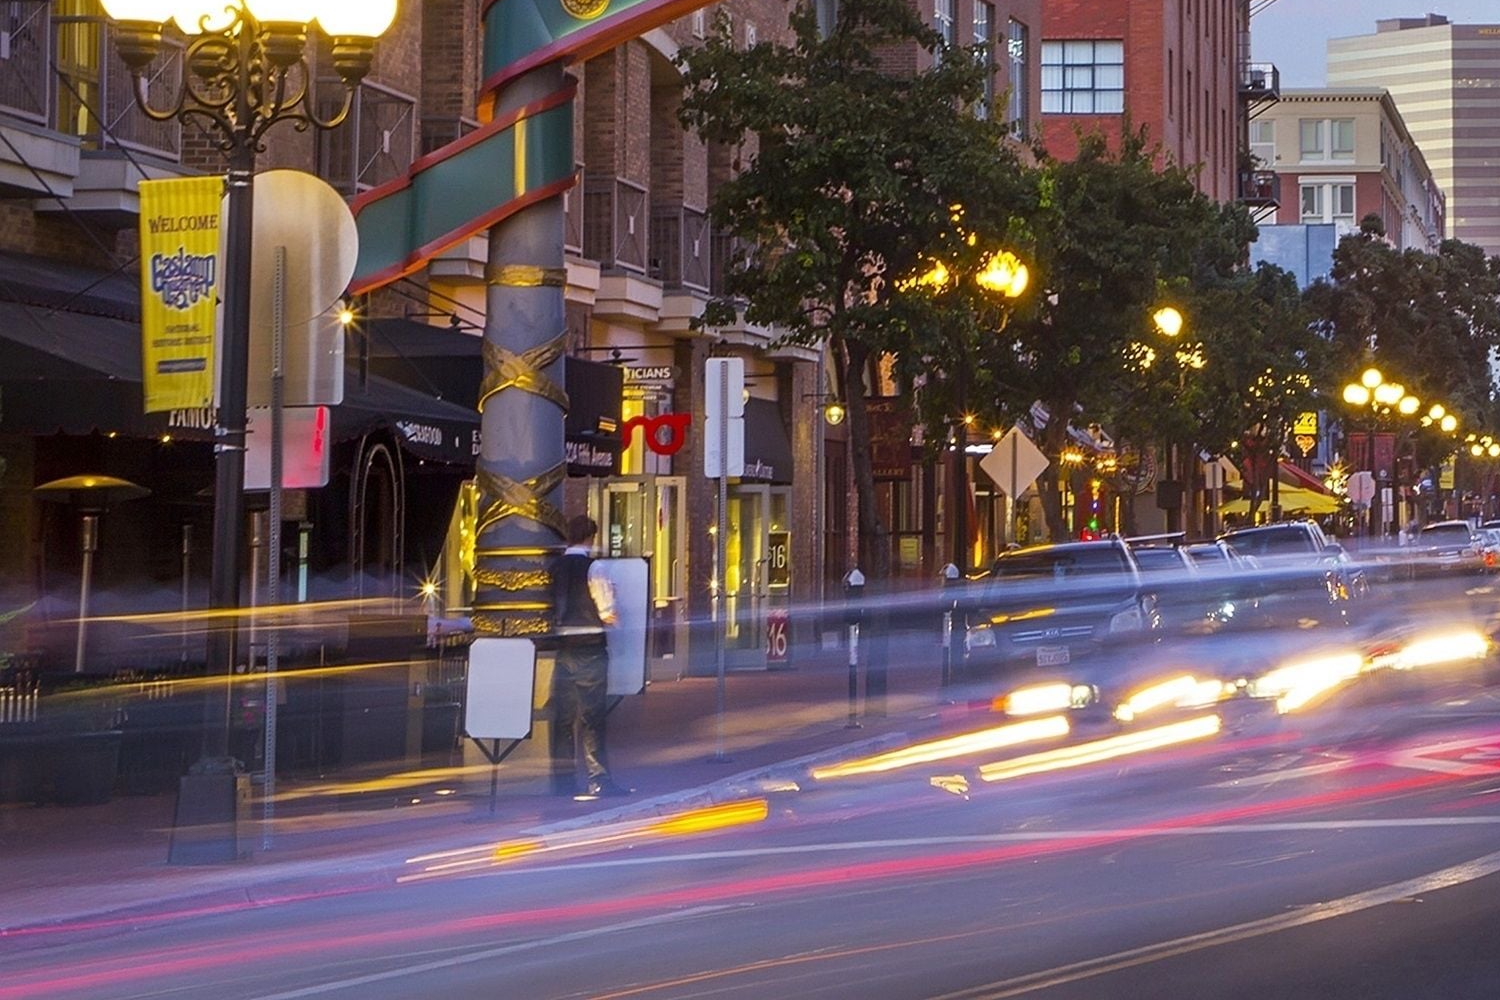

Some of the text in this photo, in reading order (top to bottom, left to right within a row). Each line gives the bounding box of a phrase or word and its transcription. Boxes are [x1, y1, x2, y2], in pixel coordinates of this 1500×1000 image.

[148, 214, 218, 234] WELCOME
[152, 246, 216, 293] Gaslamp
[873, 468, 905, 476] ALLERY
